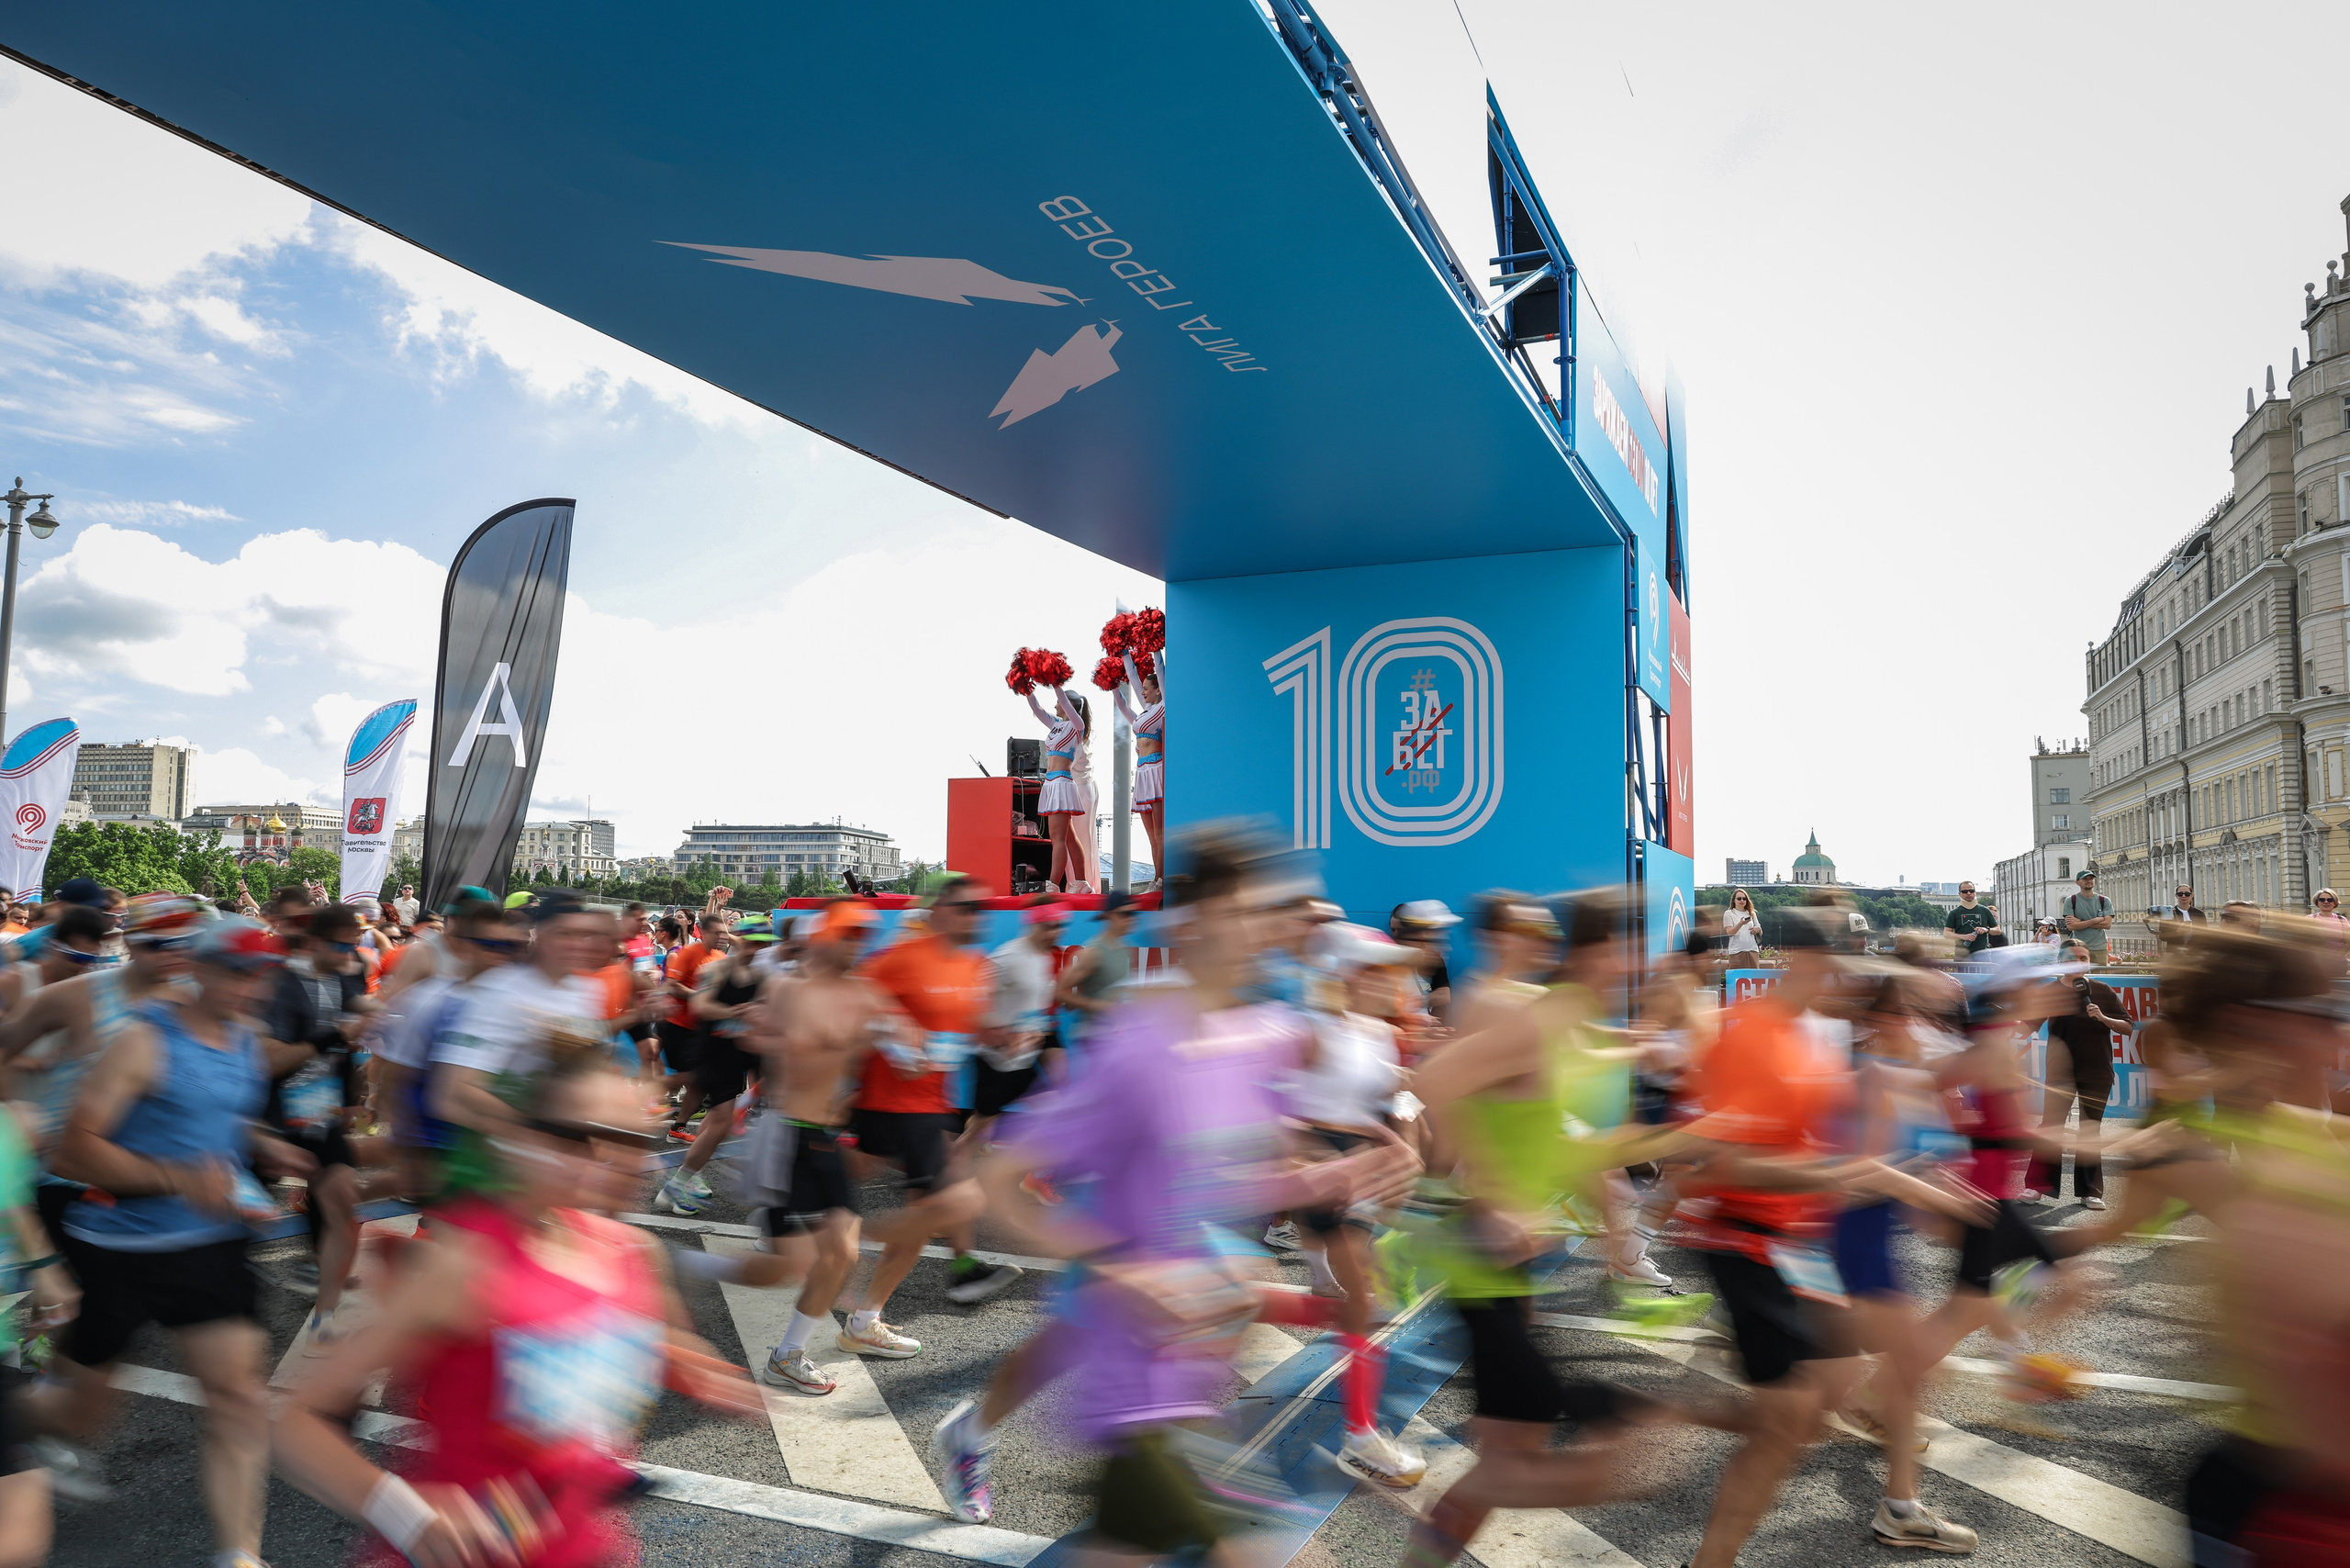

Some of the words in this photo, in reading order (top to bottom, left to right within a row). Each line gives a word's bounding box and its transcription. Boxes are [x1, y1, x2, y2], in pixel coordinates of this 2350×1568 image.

[1038, 196, 1193, 310] ГЕРОЕВ
[1178, 314, 1268, 372] ЛИГА
[1262, 616, 1505, 847] 10
[1401, 690, 1444, 731] ЗА
[1393, 729, 1453, 770] БЕГ
[15, 840, 43, 852] Трнспорт
